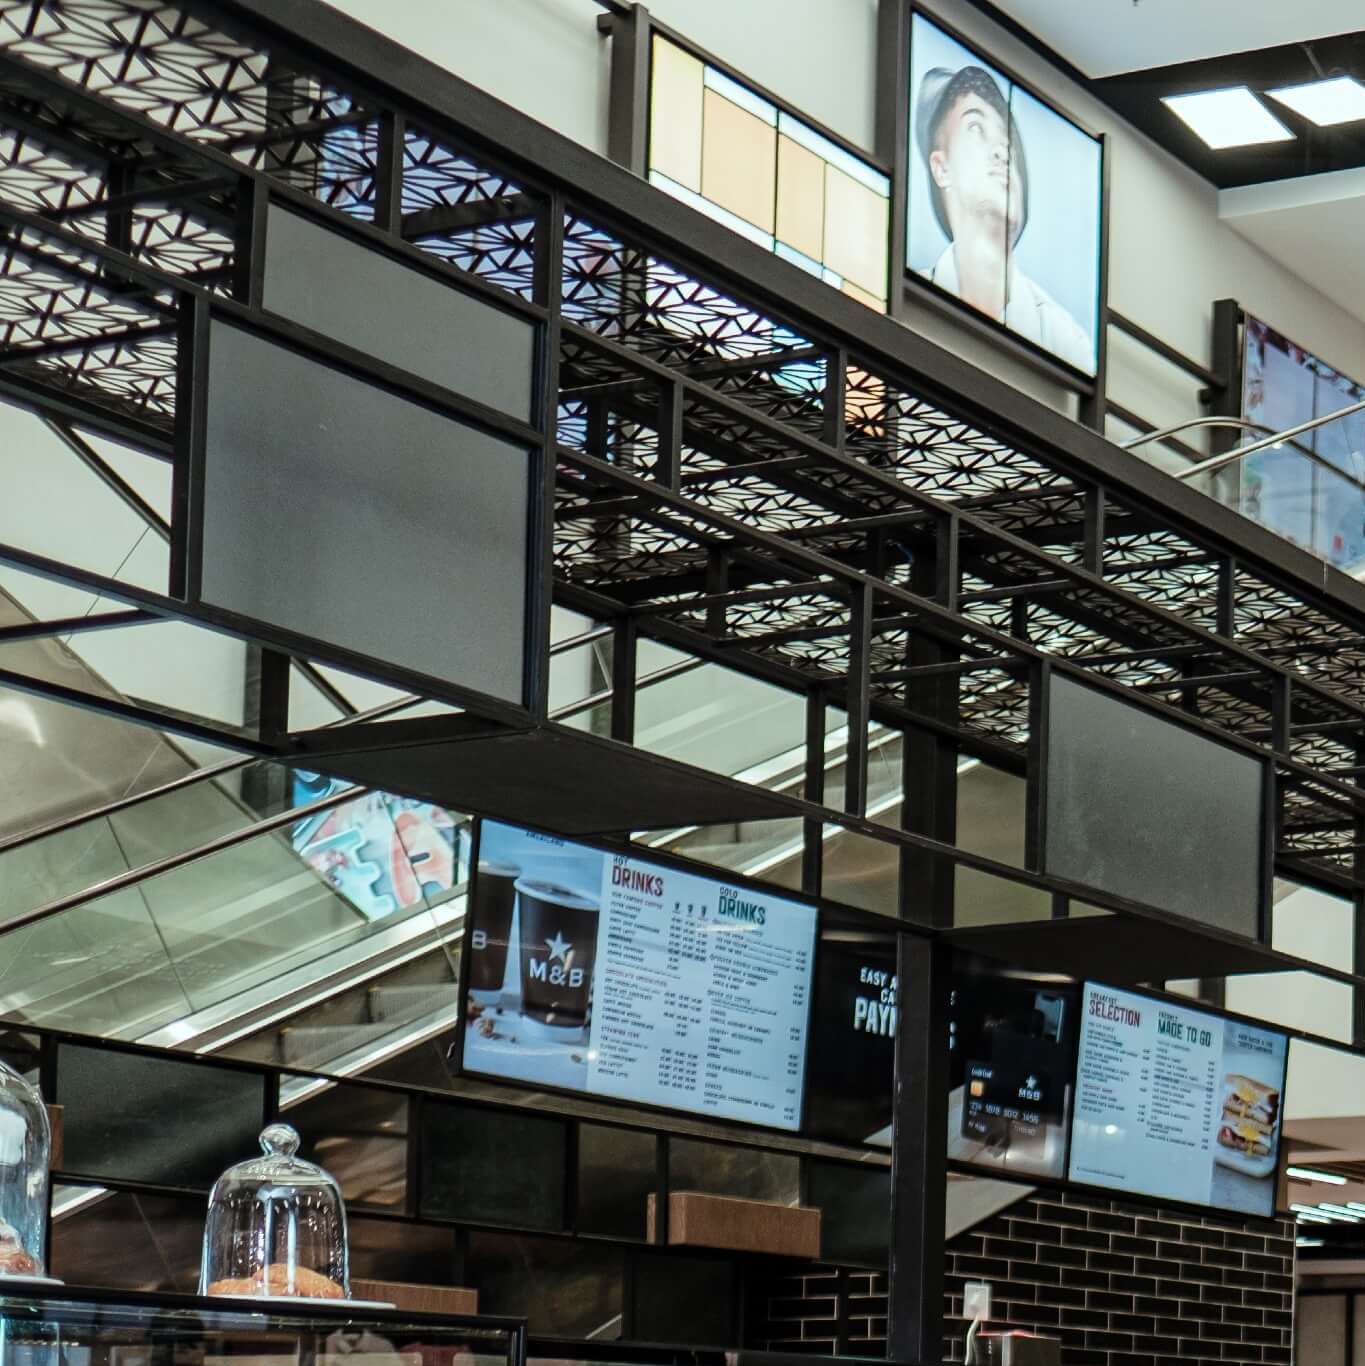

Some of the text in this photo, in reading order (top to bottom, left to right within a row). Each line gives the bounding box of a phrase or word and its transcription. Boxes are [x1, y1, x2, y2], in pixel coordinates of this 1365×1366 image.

[612, 865, 664, 896] DRINKS
[719, 896, 766, 925] DRINKS
[529, 957, 584, 988] M&B
[860, 966, 888, 987] EASY
[1089, 999, 1141, 1028] SELECTION
[1158, 1019, 1212, 1048] MADE TO GO
